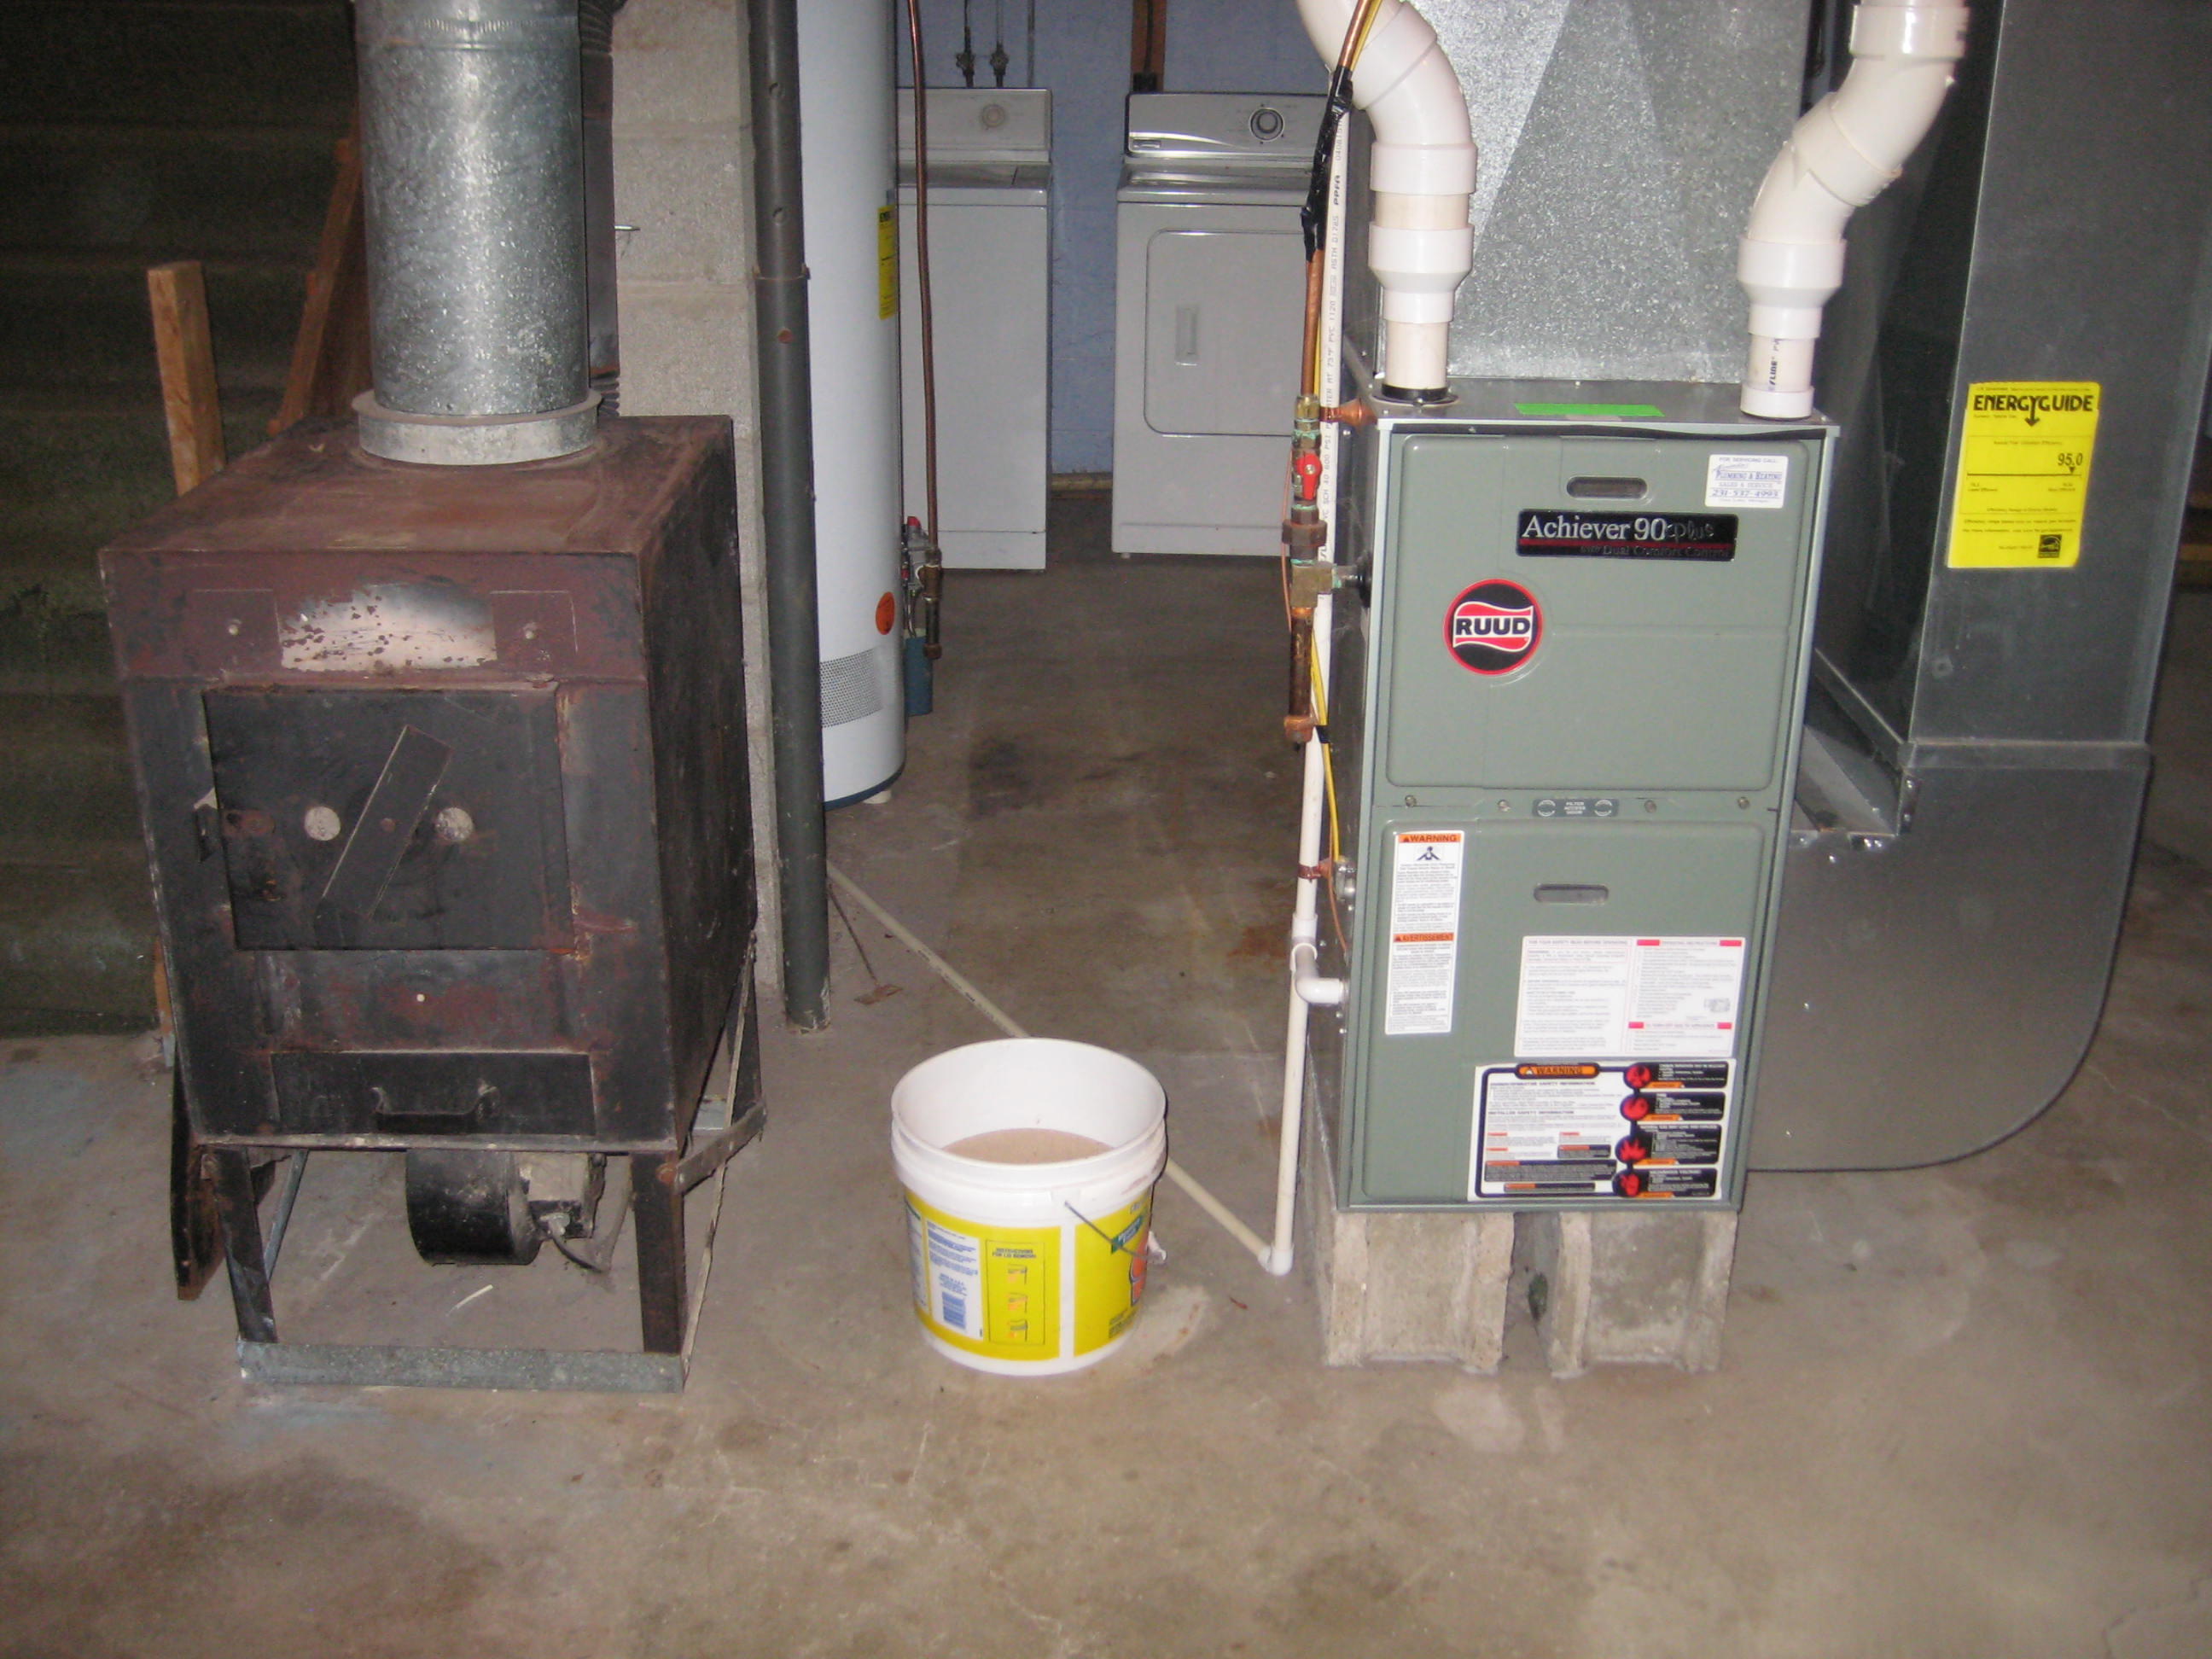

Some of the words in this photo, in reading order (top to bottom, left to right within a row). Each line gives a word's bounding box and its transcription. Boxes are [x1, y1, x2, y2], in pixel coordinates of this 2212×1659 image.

[1972, 394, 2093, 415] ENERGYGUIDE
[2058, 452, 2083, 467] 95.0
[1522, 515, 1630, 539] Achiever
[1603, 545, 1630, 556] Dual
[1633, 545, 1680, 556] Comfort
[1455, 617, 1531, 636] RUUD
[1410, 834, 1458, 842] WARNING
[1536, 1067, 1582, 1075] WARNING
